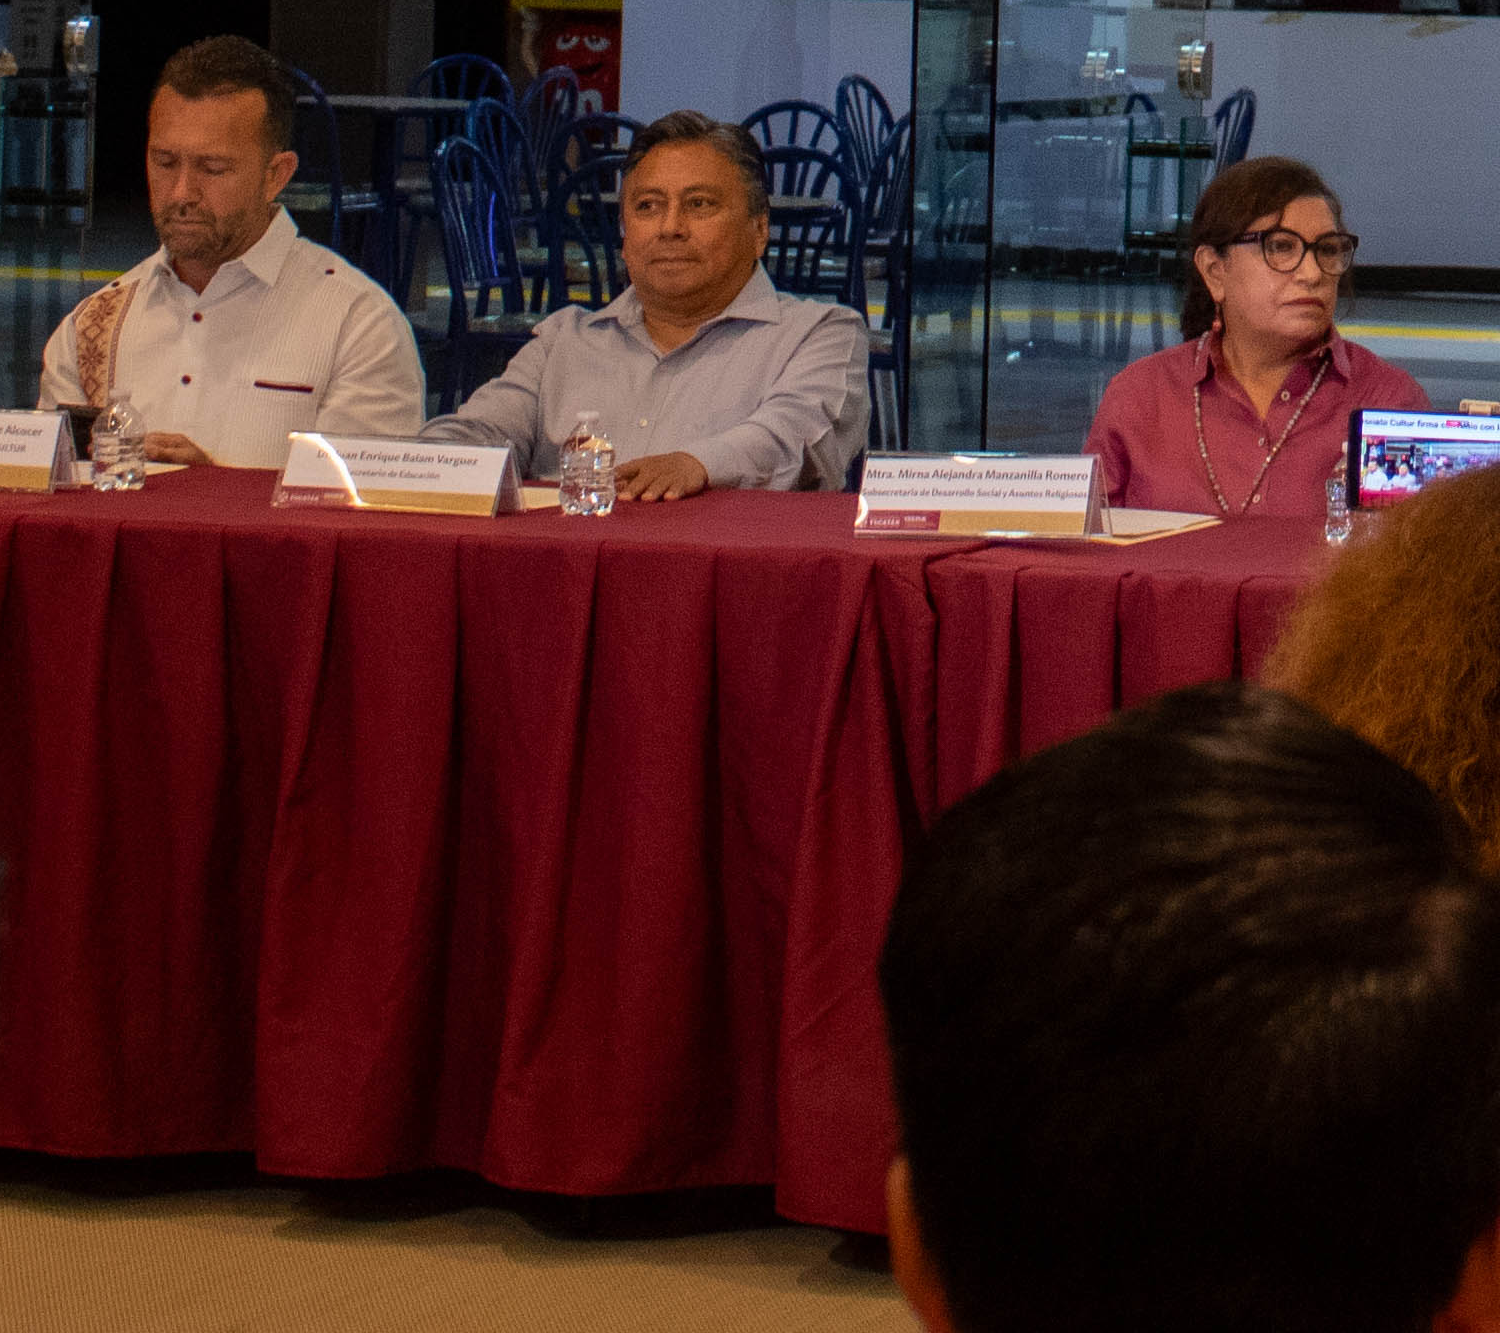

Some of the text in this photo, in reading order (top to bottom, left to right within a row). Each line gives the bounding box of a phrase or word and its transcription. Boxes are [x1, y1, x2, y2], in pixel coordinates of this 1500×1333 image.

[3, 424, 43, 437] Alcocer
[1417, 419, 1439, 429] firma
[336, 450, 479, 469] uan Enrique Balam Varguez
[348, 469, 388, 479] ecretario
[866, 468, 1088, 482] Mtra. Mirna Alejandra Manzanilla Romero
[931, 489, 975, 498] Desarrollo
[976, 488, 1001, 498] Social
[1008, 490, 1043, 499] Asuntos
[1045, 489, 1087, 501] Religiosos
